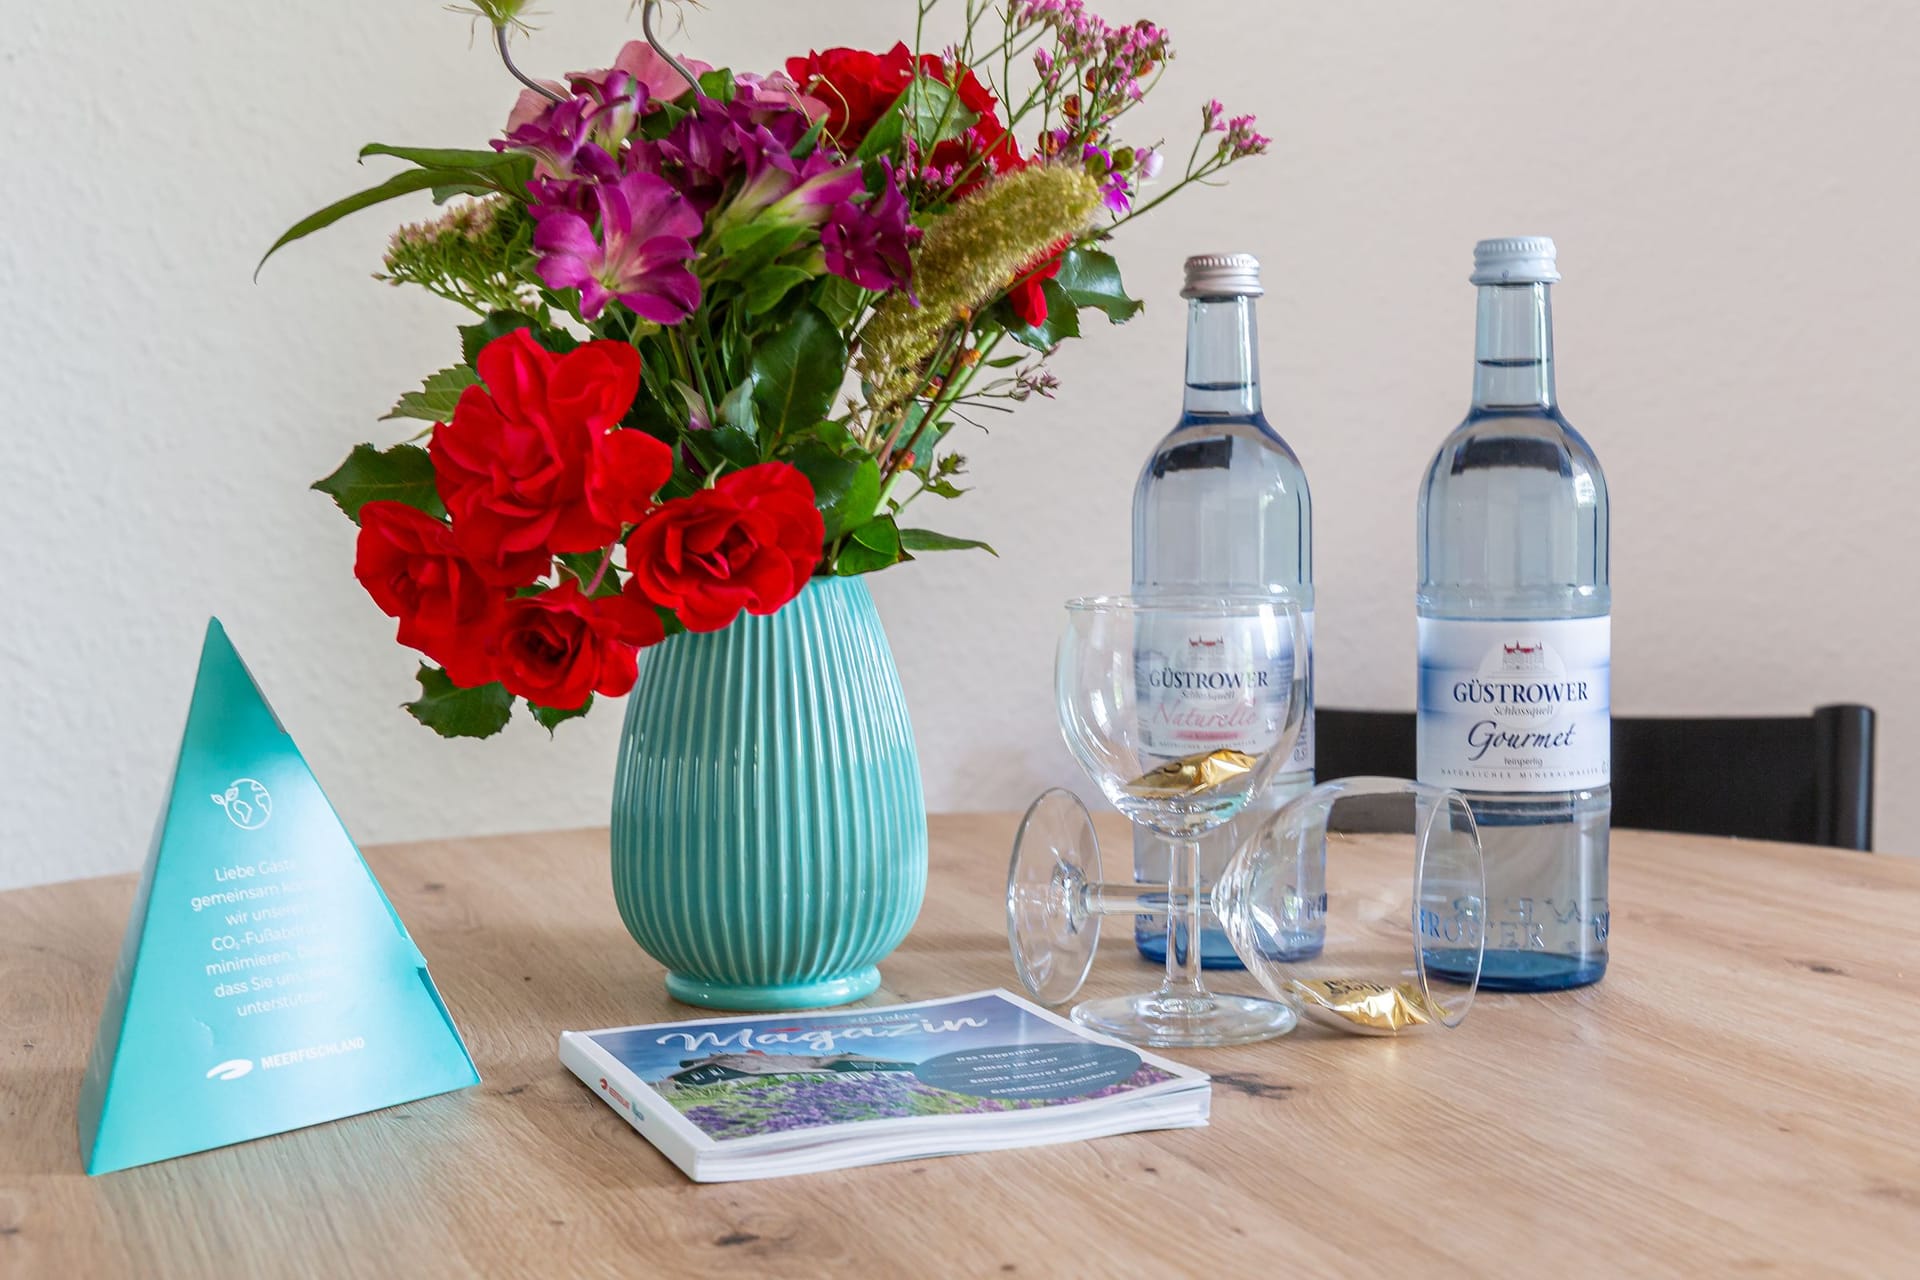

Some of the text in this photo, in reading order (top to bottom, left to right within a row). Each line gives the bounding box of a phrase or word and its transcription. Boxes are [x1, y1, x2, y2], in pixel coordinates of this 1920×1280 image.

[1150, 667, 1269, 690] GÜSTROWER
[1453, 679, 1588, 703] GÜSTROWER
[1493, 705, 1554, 718] Schlossquell
[1468, 720, 1576, 761] Gourmet
[214, 864, 256, 882] Liebe
[190, 884, 279, 912] gemeinsam
[224, 910, 248, 926] wir
[214, 981, 249, 998] dass
[251, 975, 273, 991] Sie
[656, 1016, 988, 1051] Magazin
[260, 1036, 365, 1071] MEERFISCHLAND
